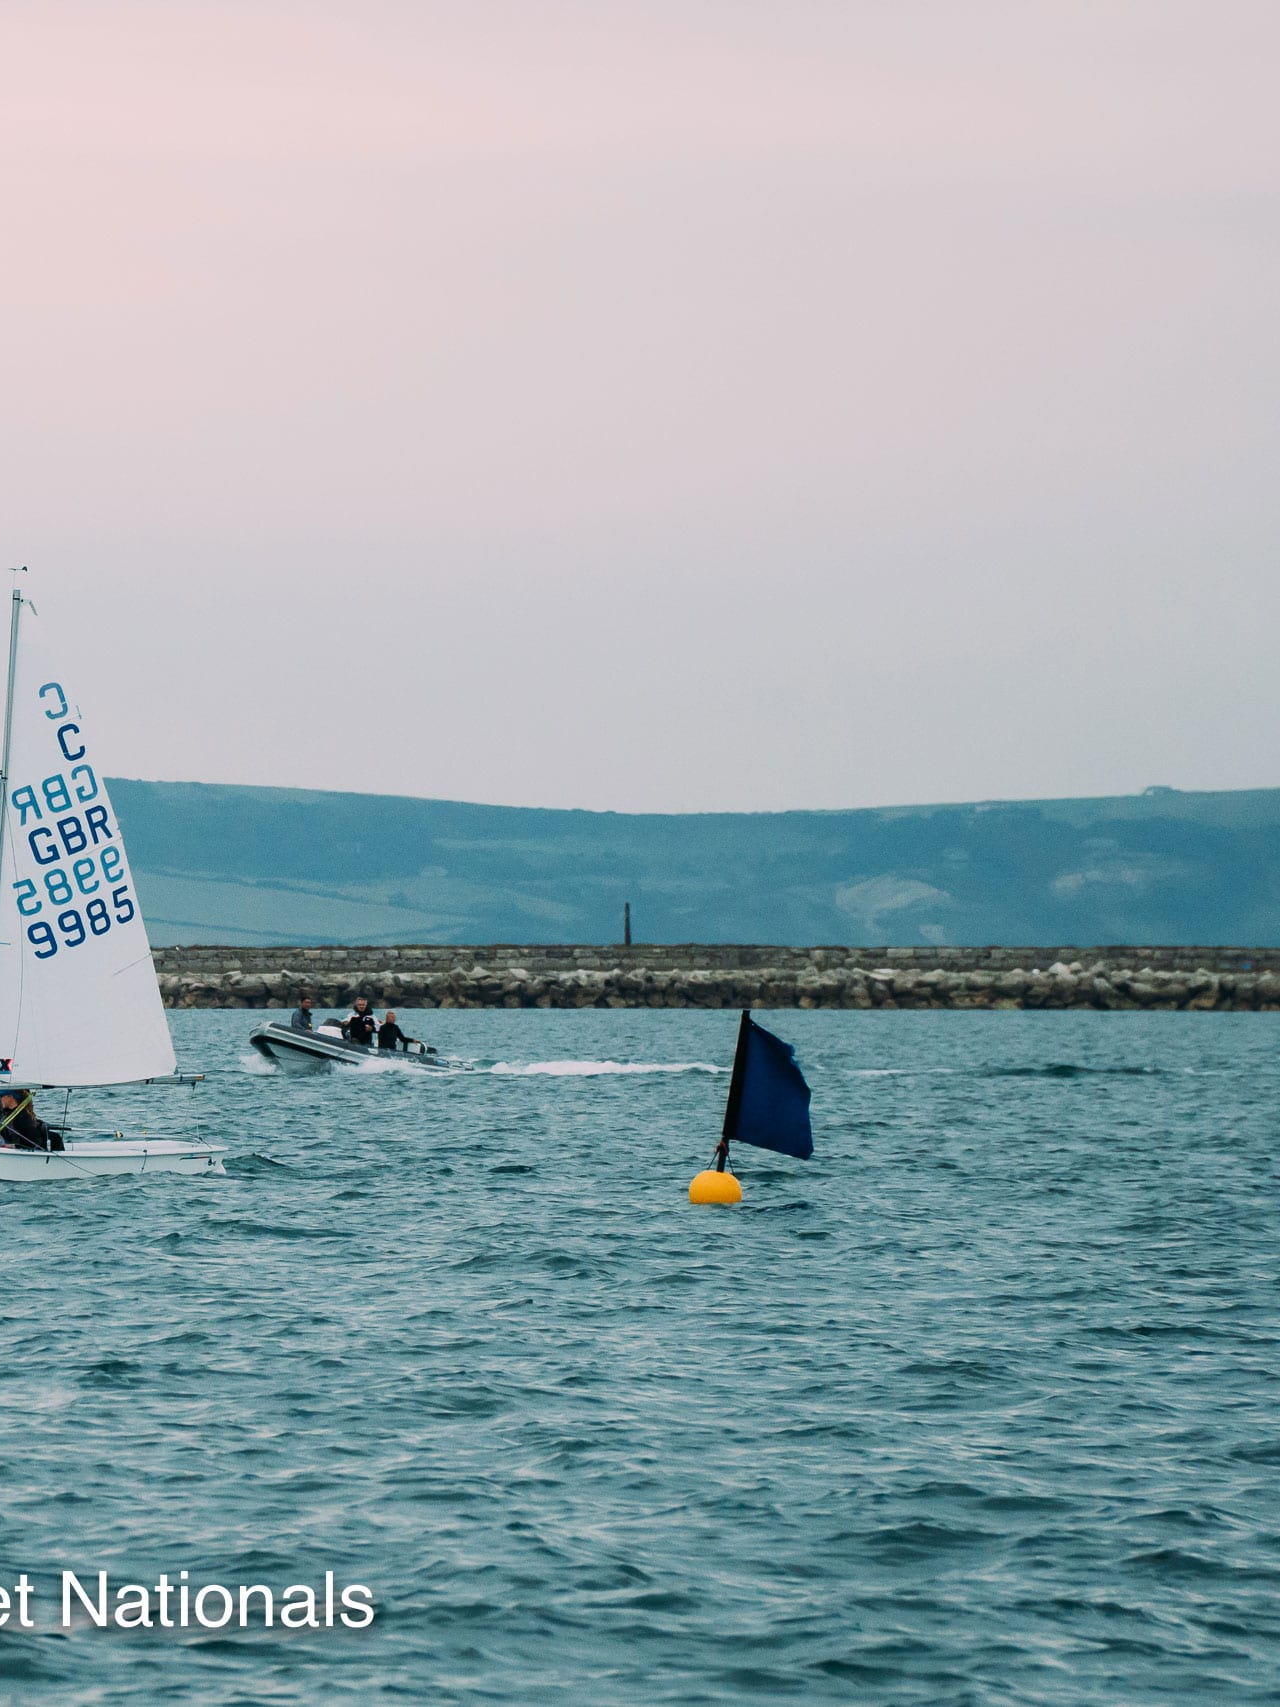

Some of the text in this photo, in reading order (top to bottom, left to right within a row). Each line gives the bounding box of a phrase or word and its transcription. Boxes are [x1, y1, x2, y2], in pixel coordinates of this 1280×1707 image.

[57, 723, 86, 762] C
[28, 804, 113, 866] GBR
[27, 885, 135, 960] 9985
